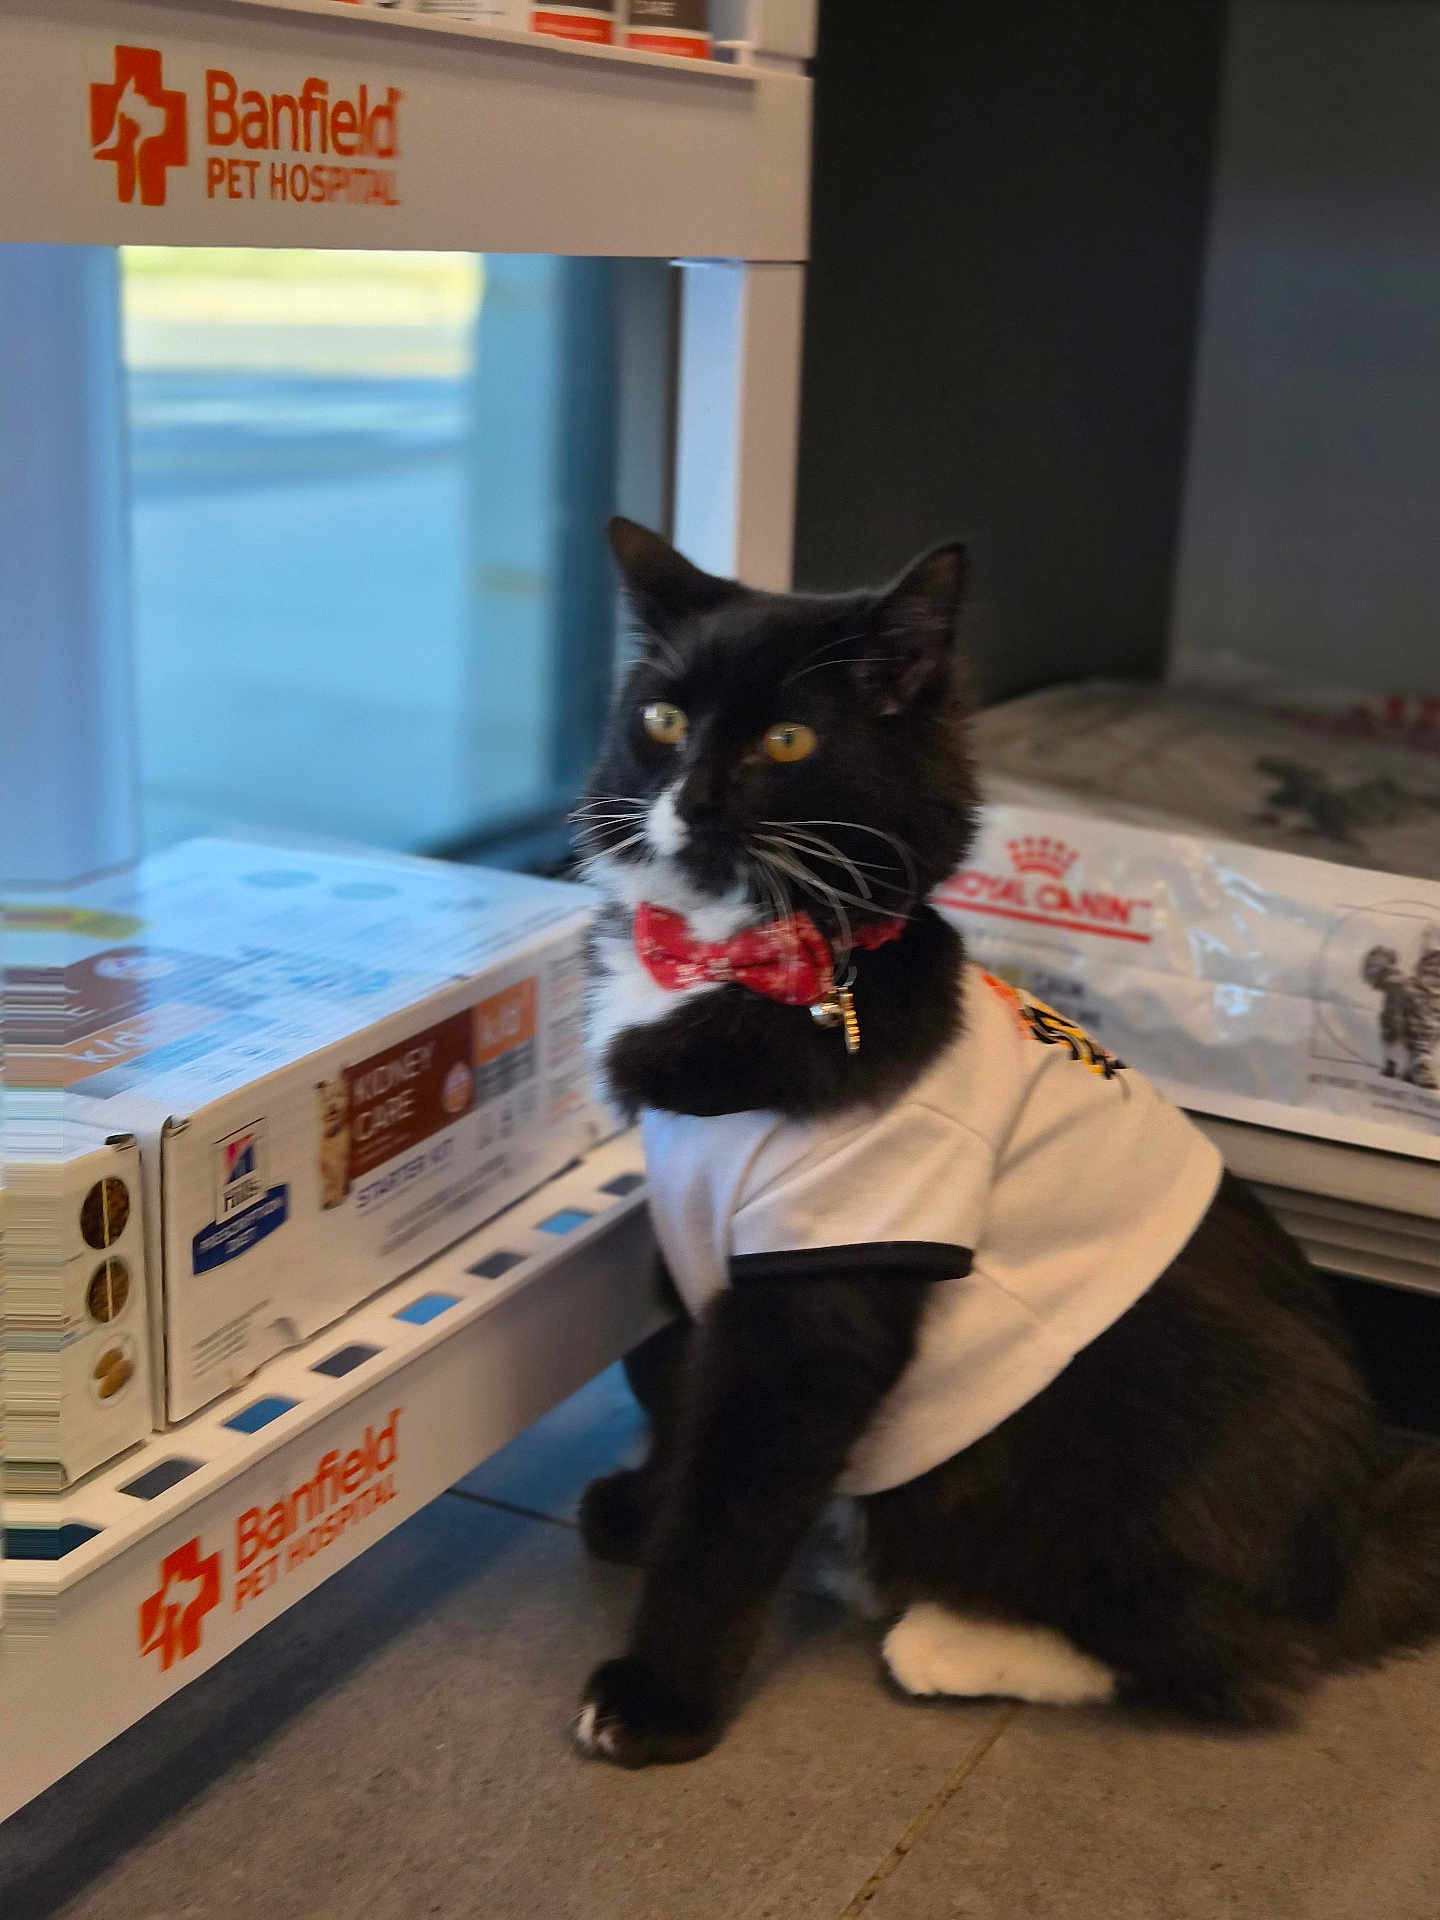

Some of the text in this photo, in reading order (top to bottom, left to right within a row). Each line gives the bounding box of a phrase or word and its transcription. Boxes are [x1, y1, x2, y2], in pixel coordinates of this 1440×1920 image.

[206, 69, 400, 159] Banfield
[207, 157, 400, 206] PET HOSPITAL
[352, 1042, 435, 1102] KIDNEY
[354, 1087, 416, 1142] CARE
[235, 1408, 402, 1571] Banfield
[233, 1474, 398, 1612] PET HOSPITAL
